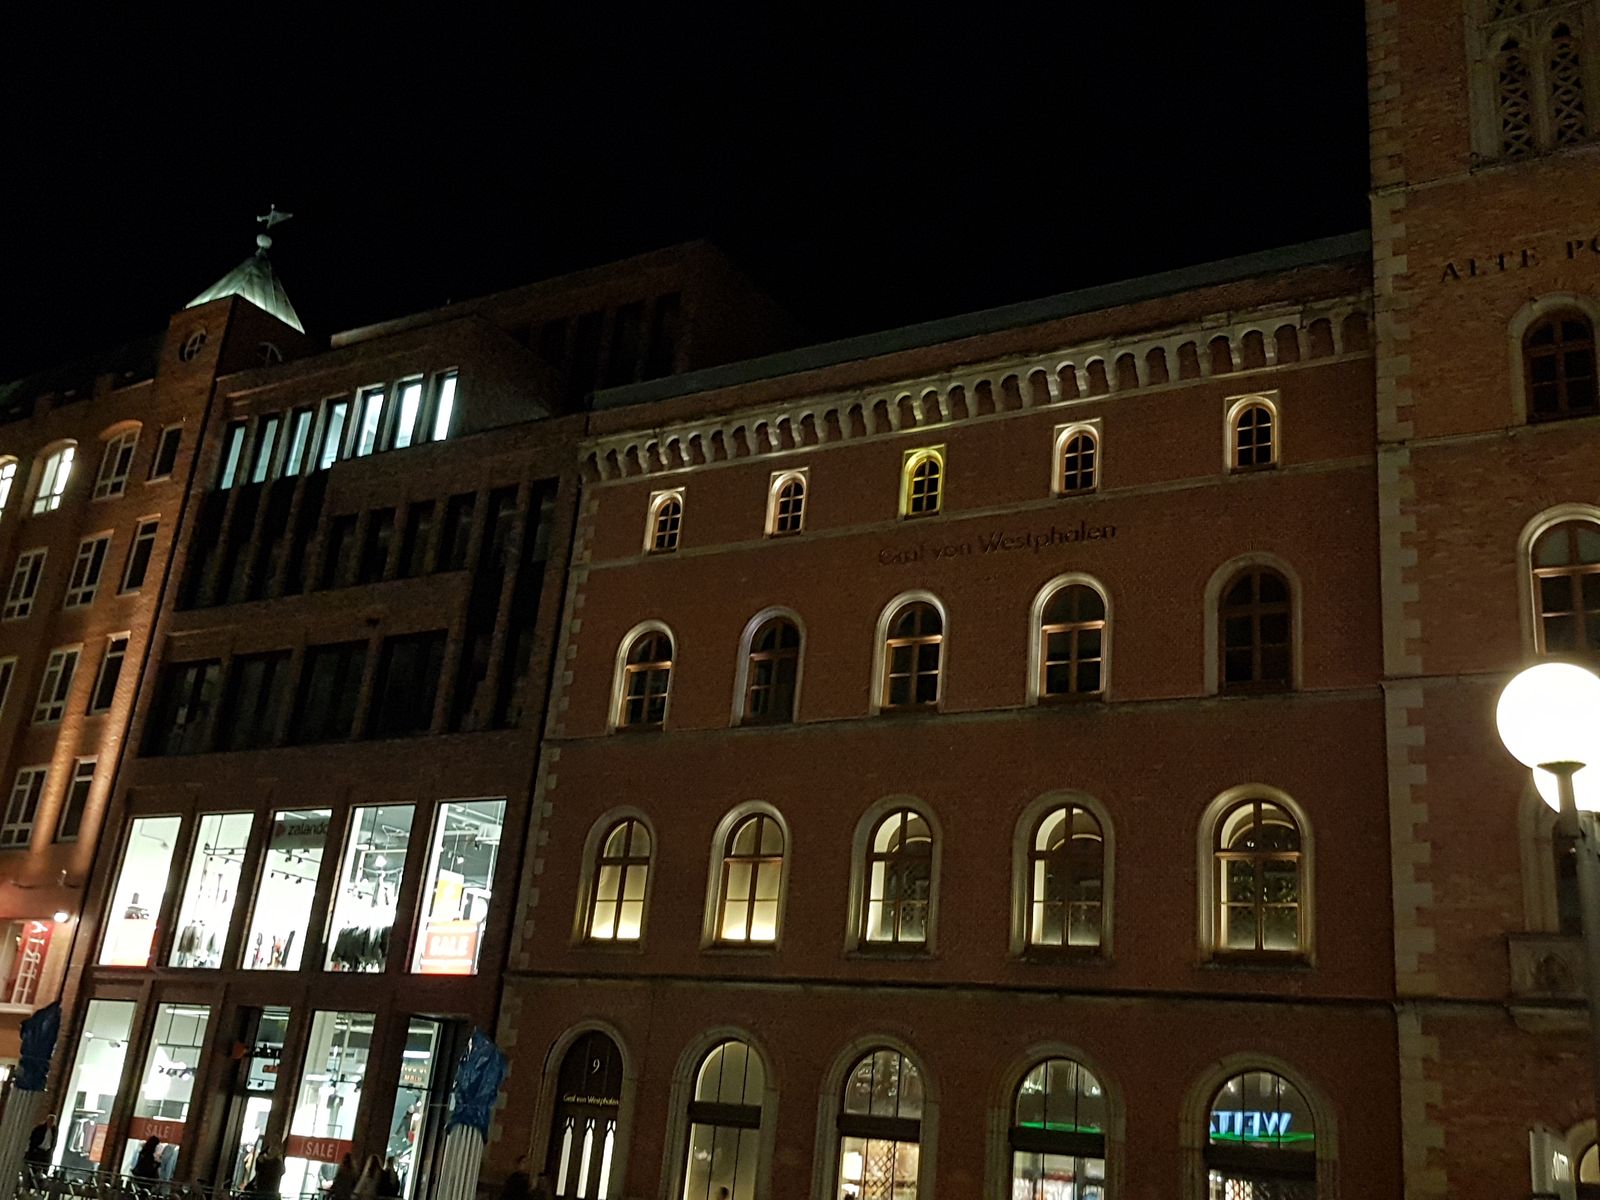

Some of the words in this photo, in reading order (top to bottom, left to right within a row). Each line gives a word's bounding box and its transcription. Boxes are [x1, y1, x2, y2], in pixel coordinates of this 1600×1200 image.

[1440, 245, 1539, 282] ALTE
[932, 541, 972, 561] von
[977, 520, 1117, 554] Westphalen
[428, 935, 469, 956] SALE
[592, 1058, 600, 1074] 9
[144, 1123, 170, 1139] SALE
[306, 1141, 334, 1158] SALE
